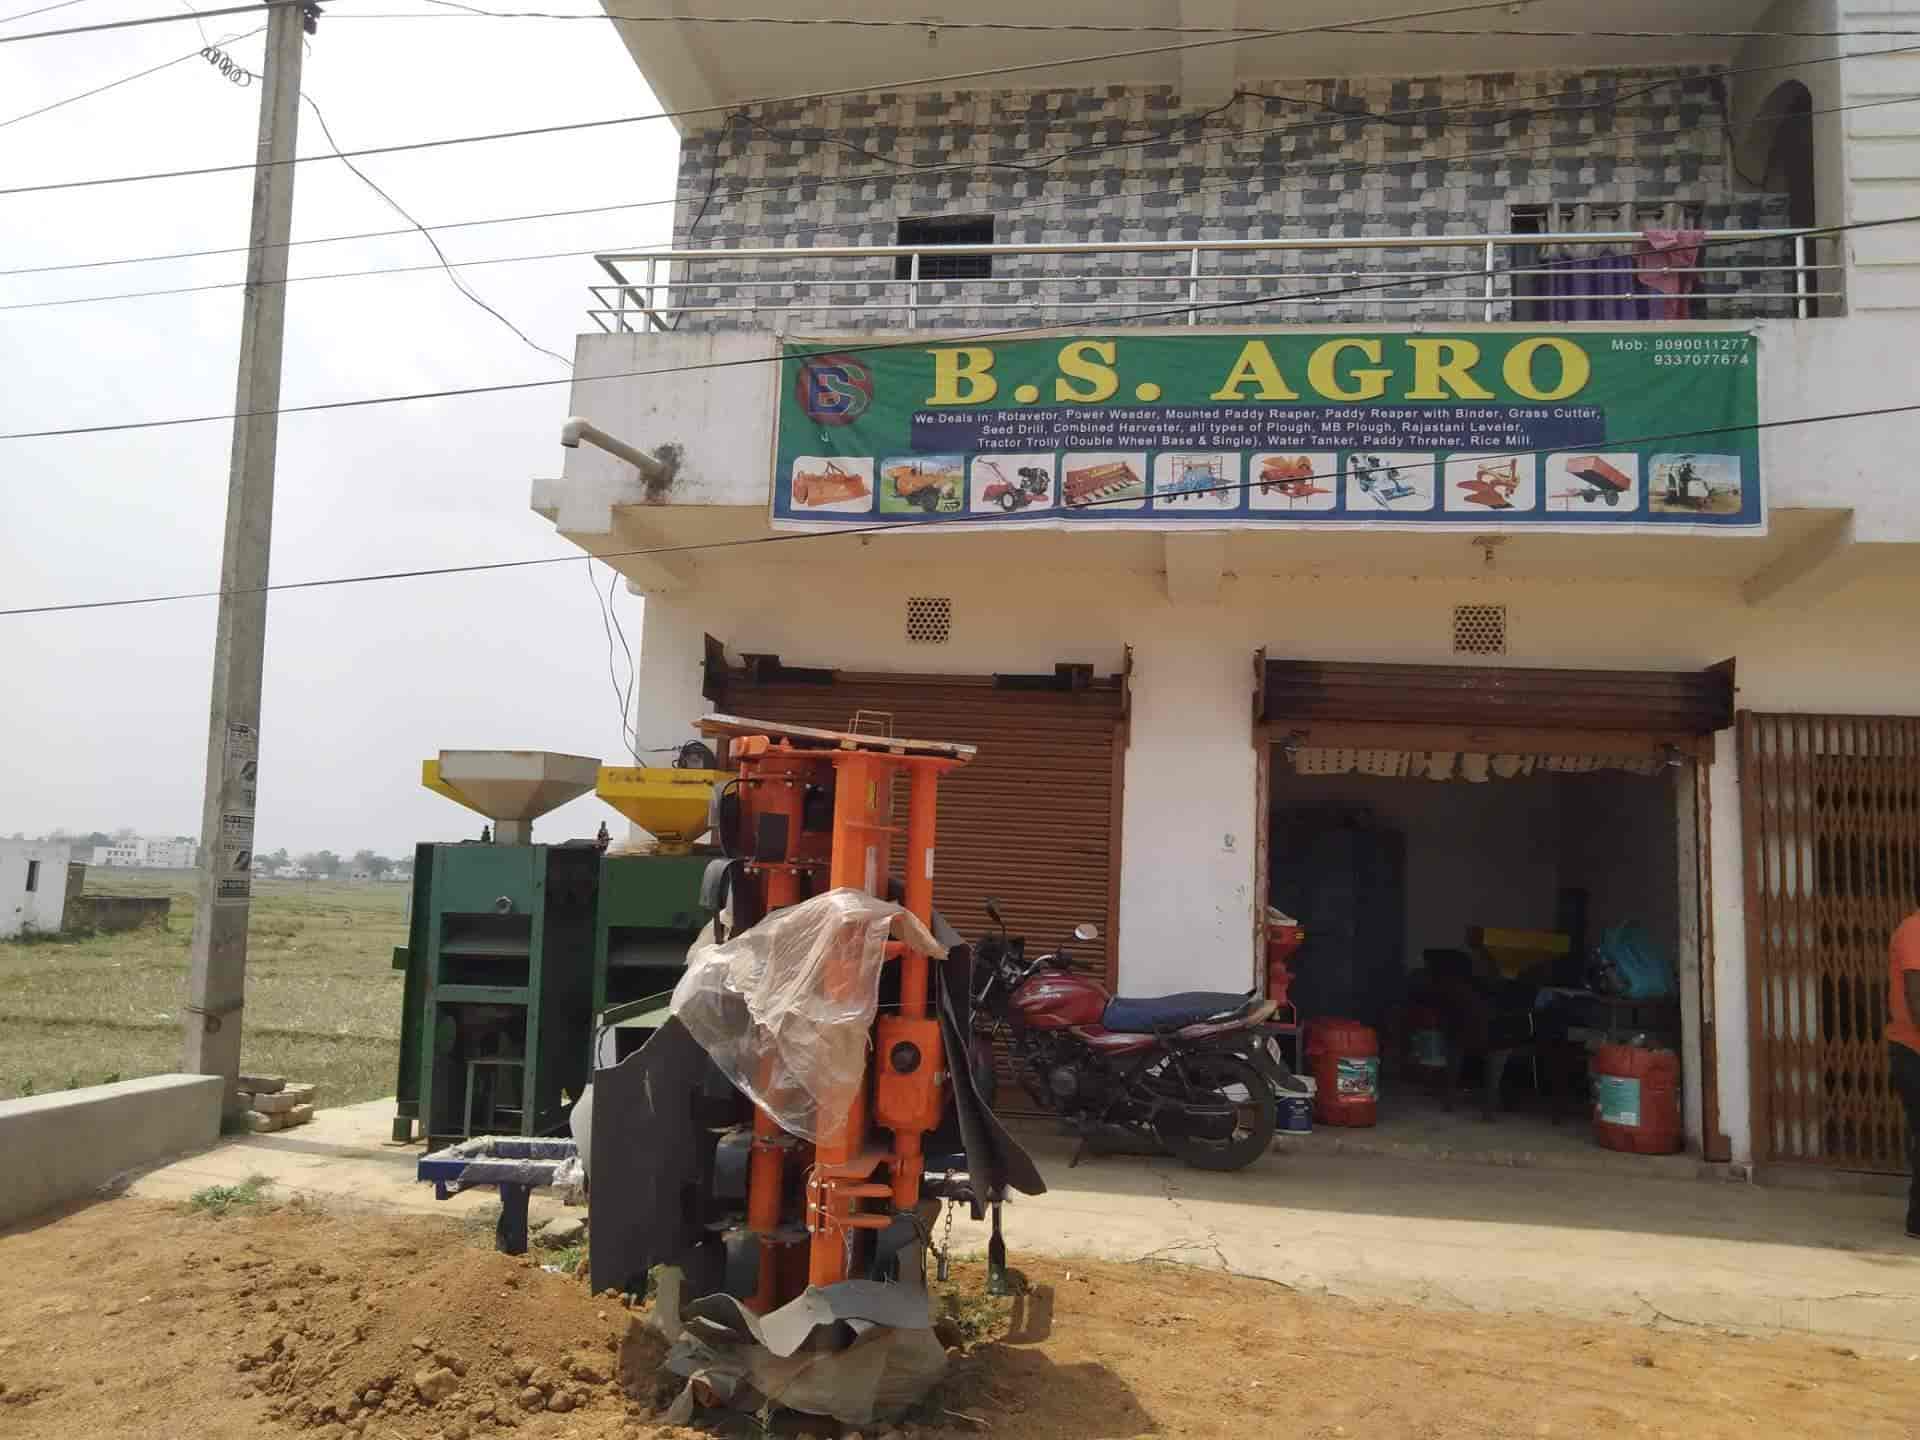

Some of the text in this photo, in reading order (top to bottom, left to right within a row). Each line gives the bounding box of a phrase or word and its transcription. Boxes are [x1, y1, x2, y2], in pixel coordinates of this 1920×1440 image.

[1611, 338, 1749, 351] Mob: 9090011277
[924, 336, 1592, 407] B.S. AGRO
[914, 414, 934, 425] We
[938, 413, 973, 424] Deals
[1066, 409, 1105, 420] Power
[1166, 408, 1220, 419] Mounted
[1225, 408, 1265, 421] Paddy
[1269, 408, 1320, 421] Reaper,
[1325, 408, 1367, 421] Paddy
[1371, 408, 1418, 421] Reaper
[1423, 408, 1450, 419] with
[1455, 408, 1504, 420] Binder,
[1508, 408, 1549, 419] Grass
[1554, 408, 1601, 420] Cutter,
[983, 425, 1014, 435] Seed
[1018, 424, 1048, 436] Drill,
[1053, 423, 1114, 434] Combined
[1119, 423, 1185, 434] Harvester,
[1190, 423, 1206, 433] all
[1210, 422, 1245, 435] types
[1250, 422, 1262, 433] of
[1266, 422, 1317, 435] Plough,
[1321, 422, 1342, 433] MB
[1347, 422, 1397, 435] Plough,
[1402, 422, 1465, 435] Rajastani
[977, 438, 1022, 449] Tractor
[1027, 437, 1060, 449] Trolly
[1064, 435, 1114, 448] (Double
[1117, 436, 1157, 447] Wheel
[1161, 436, 1194, 447] Base
[1198, 436, 1207, 446] &
[1212, 435, 1263, 449] Single),
[1267, 435, 1305, 447] Water
[1311, 435, 1359, 447] Tanker,
[1363, 435, 1404, 449] Paddy
[1470, 435, 1502, 446] Rice
